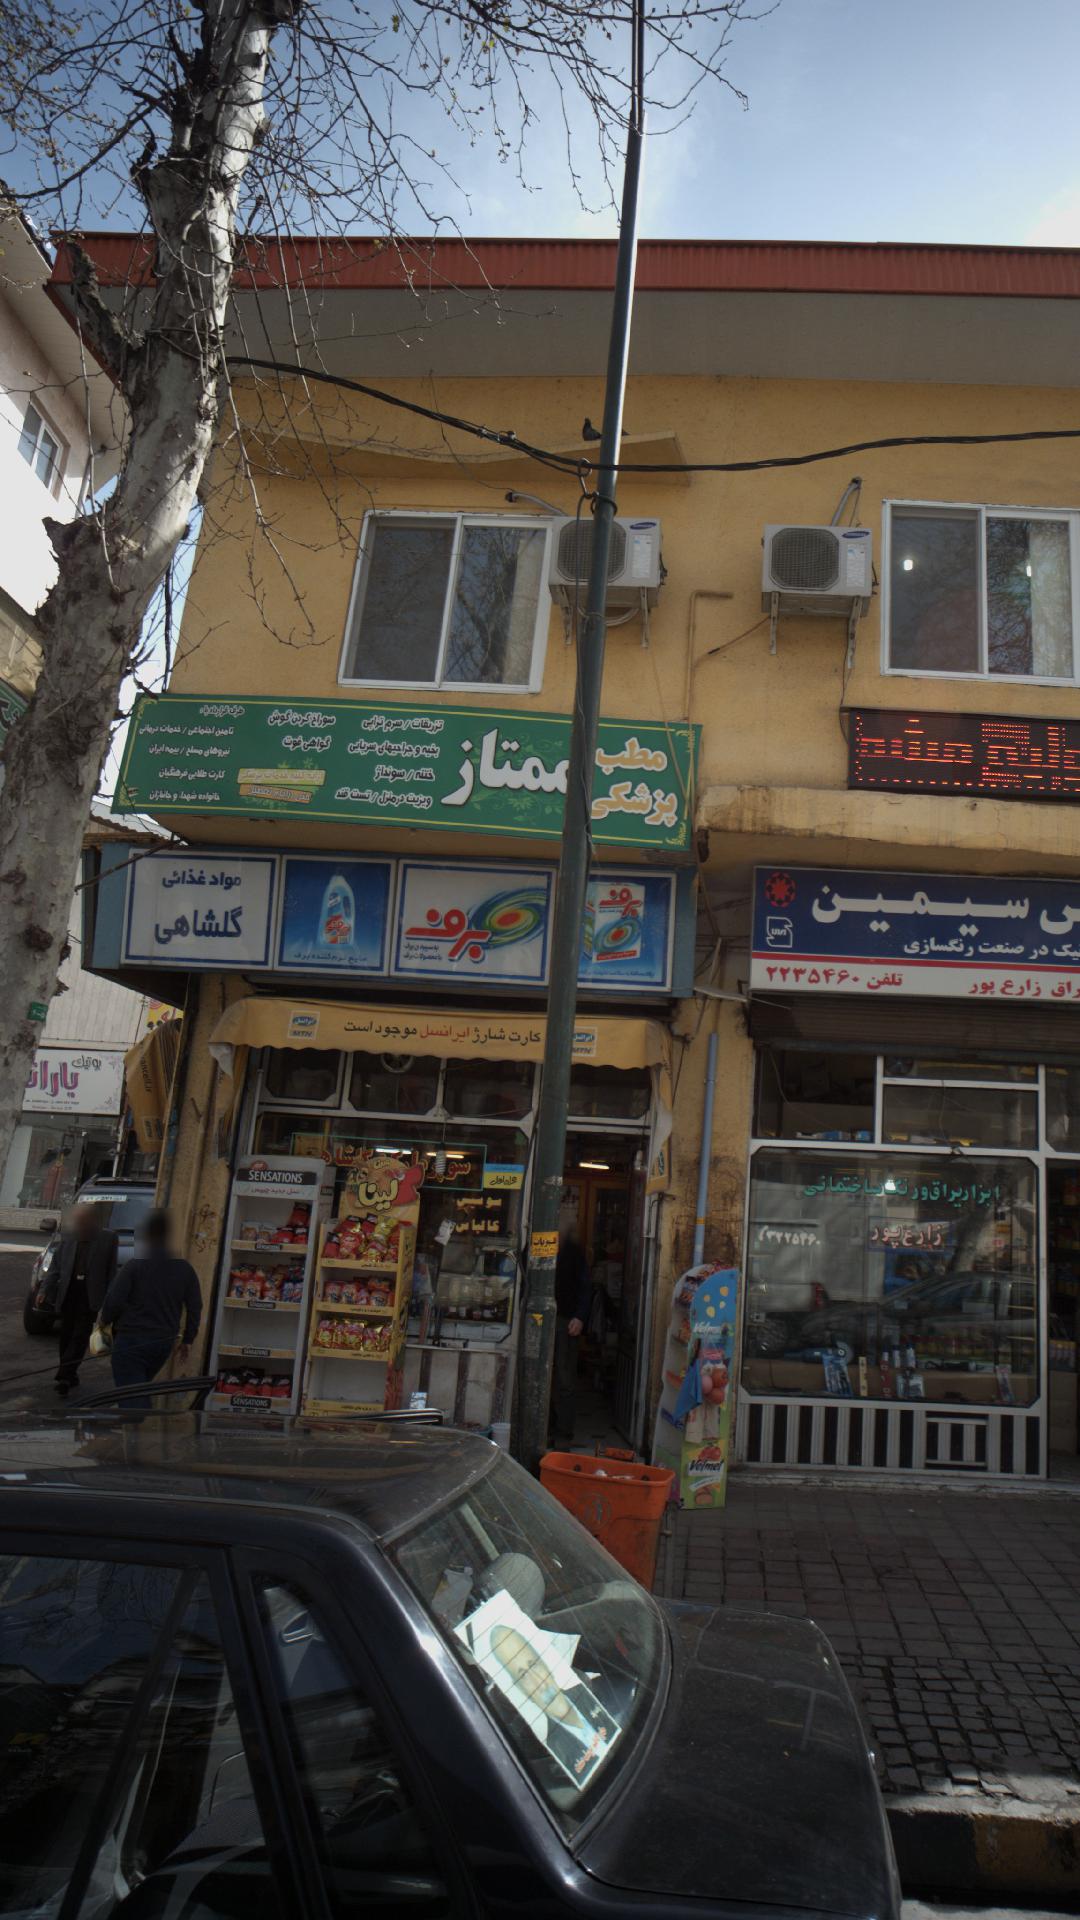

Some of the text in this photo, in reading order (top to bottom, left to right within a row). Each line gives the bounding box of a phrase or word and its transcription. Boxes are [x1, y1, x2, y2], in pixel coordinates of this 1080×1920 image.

[268, 709, 292, 726] گوش
[310, 712, 336, 728] سوراخ
[362, 715, 385, 731] تراپی
[383, 718, 403, 732] سرم
[282, 735, 332, 752] گواهی فوت
[595, 737, 668, 776] مطب
[374, 765, 435, 782] ختنه سونداژ
[440, 728, 570, 805] ممتاز
[335, 786, 351, 799] قند
[591, 781, 678, 827] پزشکی
[208, 871, 242, 890] مواد
[812, 884, 1030, 937] سیمین
[154, 906, 243, 945] گلشاهی
[404, 908, 492, 961] برف
[903, 937, 974, 957] رنگسازی
[977, 941, 1025, 955] صنعت
[1028, 944, 1048, 960] در
[765, 965, 904, 990] تلفن ۲۲۳۵۴۶۰
[968, 980, 996, 996] پور
[1000, 978, 1042, 997] زارع
[344, 1020, 542, 1046] کارت شارژ ایرانسل موجود است
[71, 1054, 102, 1071] بوتیک
[248, 1169, 305, 1184] SENSATIONS
[930, 1180, 963, 1208] یراق
[962, 1182, 1000, 1207] ابزار
[902, 1223, 943, 1247] زارع
